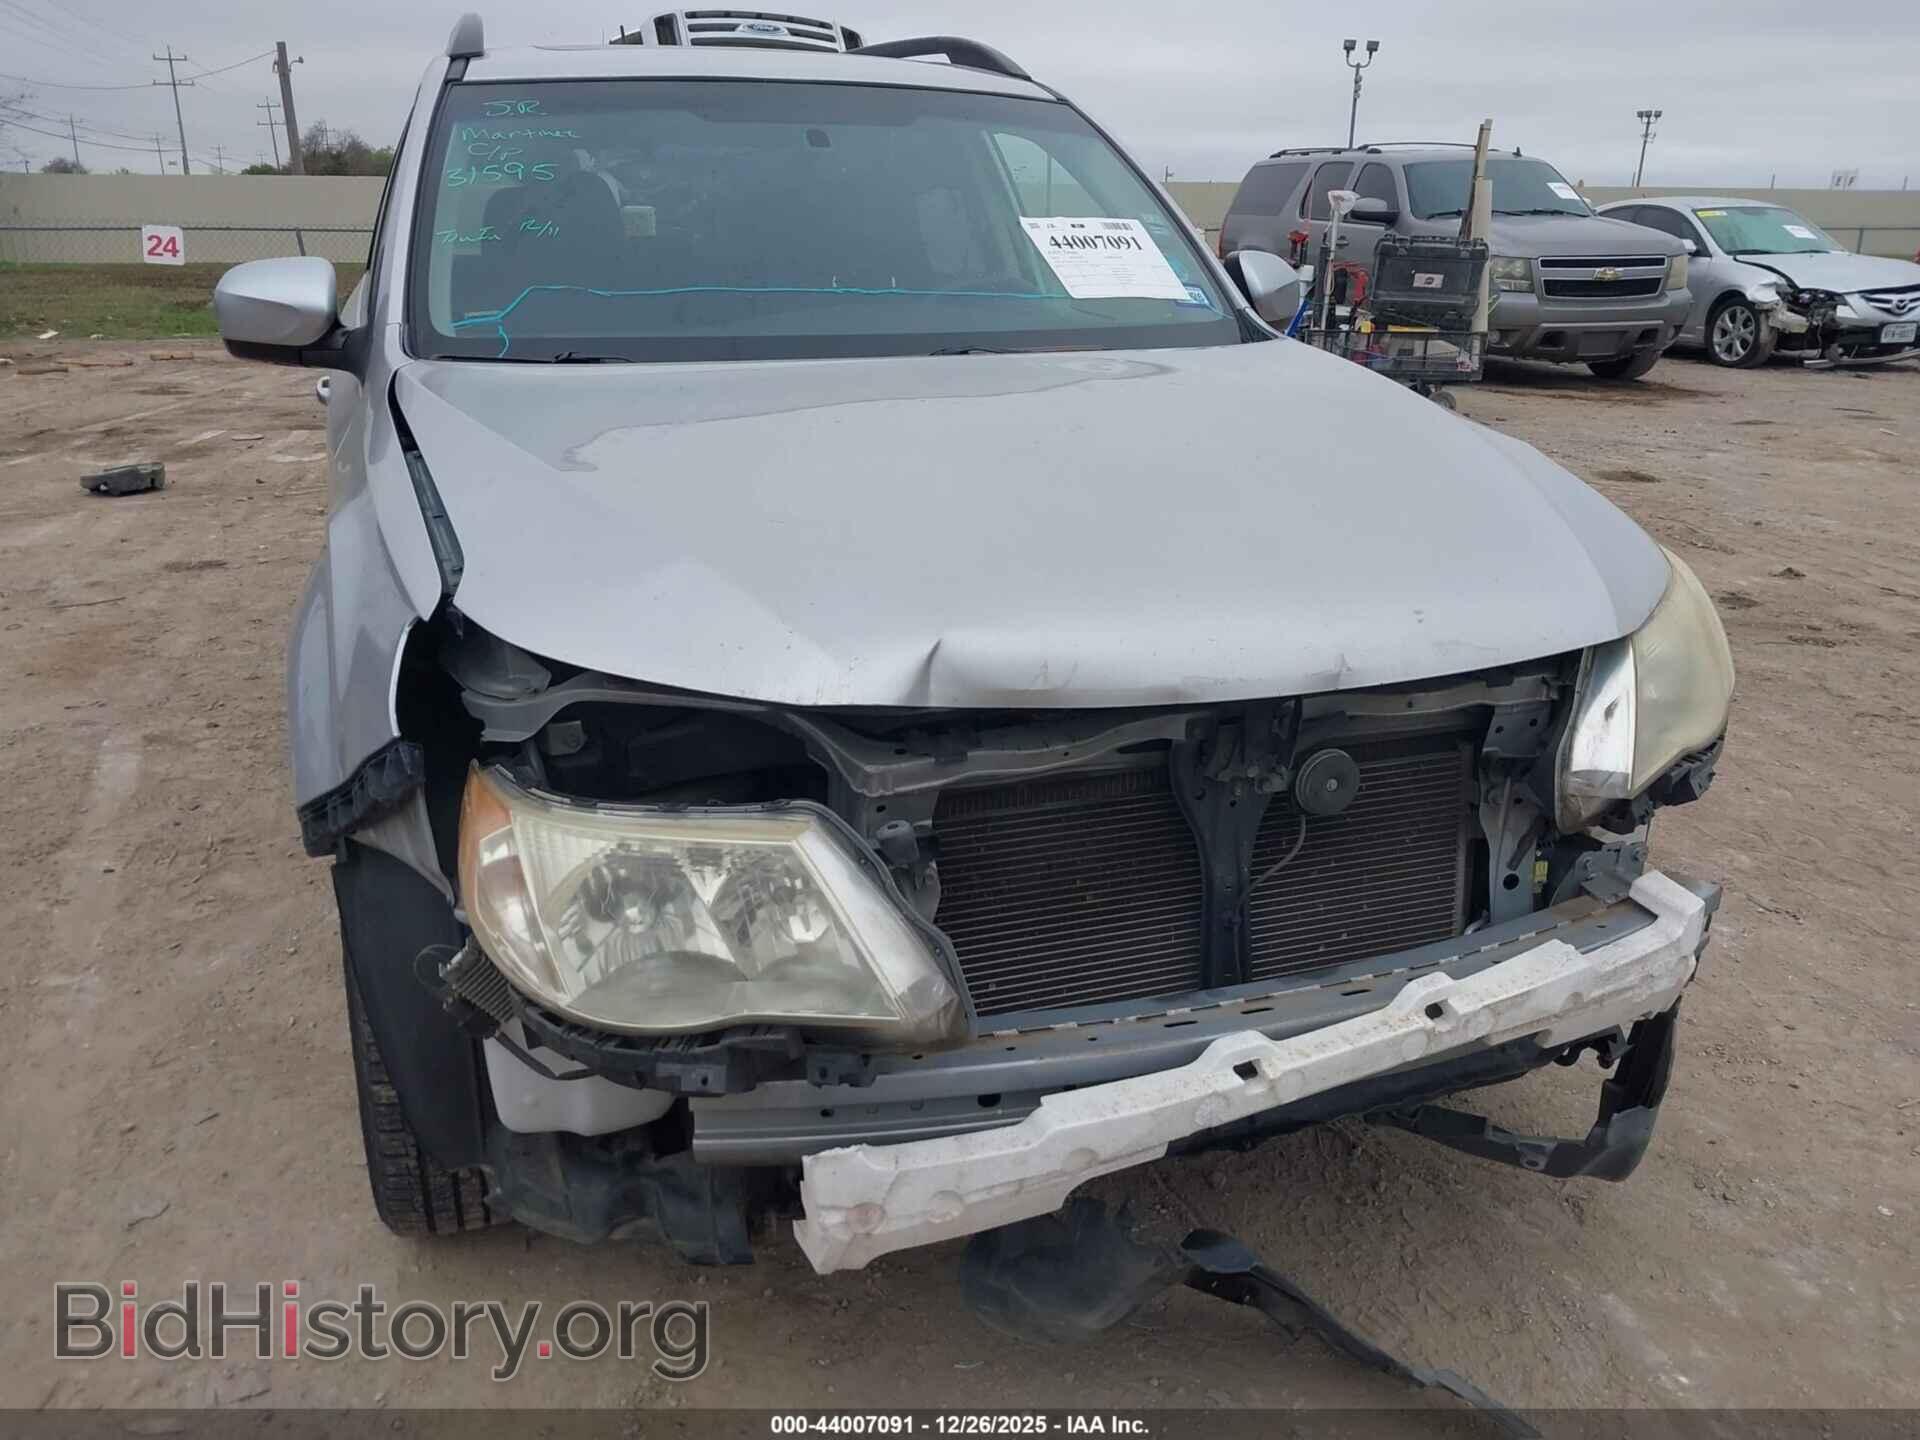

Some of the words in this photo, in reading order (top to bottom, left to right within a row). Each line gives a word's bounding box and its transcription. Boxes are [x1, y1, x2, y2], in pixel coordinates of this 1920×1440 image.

[447, 161, 558, 187] 31595
[147, 234, 180, 257] 24
[1048, 234, 1143, 251] 44007091
